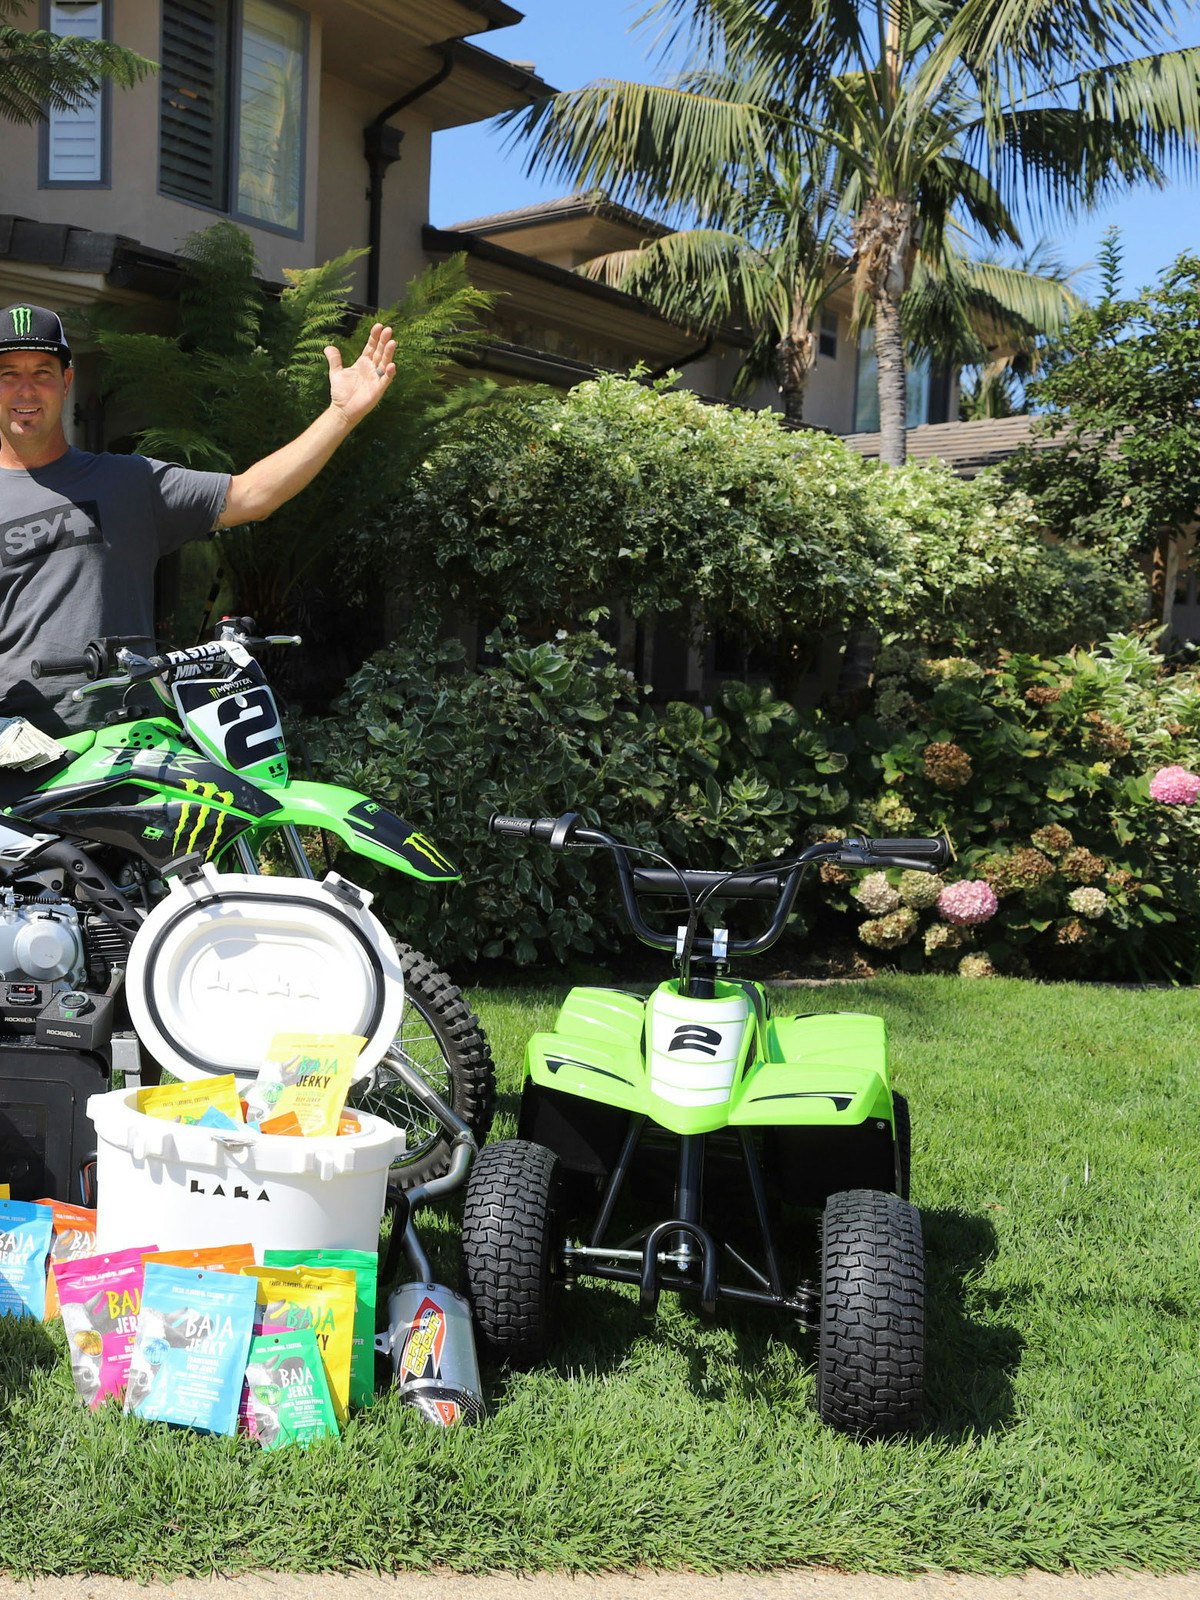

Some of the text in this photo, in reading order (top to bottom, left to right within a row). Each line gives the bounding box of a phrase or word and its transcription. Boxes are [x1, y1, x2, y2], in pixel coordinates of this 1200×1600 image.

[217, 689, 286, 771] 2
[668, 1024, 722, 1056] 2
[296, 1074, 331, 1088] JERKY
[70, 1230, 97, 1250] BAJ
[106, 1288, 141, 1319] BAJ
[116, 1316, 138, 1334] JER
[185, 1309, 234, 1339] BAJA
[287, 1301, 335, 1332] BAJA
[186, 1338, 228, 1357] JERKY
[413, 1313, 440, 1376] CIRCUIT
[279, 1367, 314, 1388] BAJA
[287, 1384, 314, 1398] JERKY
